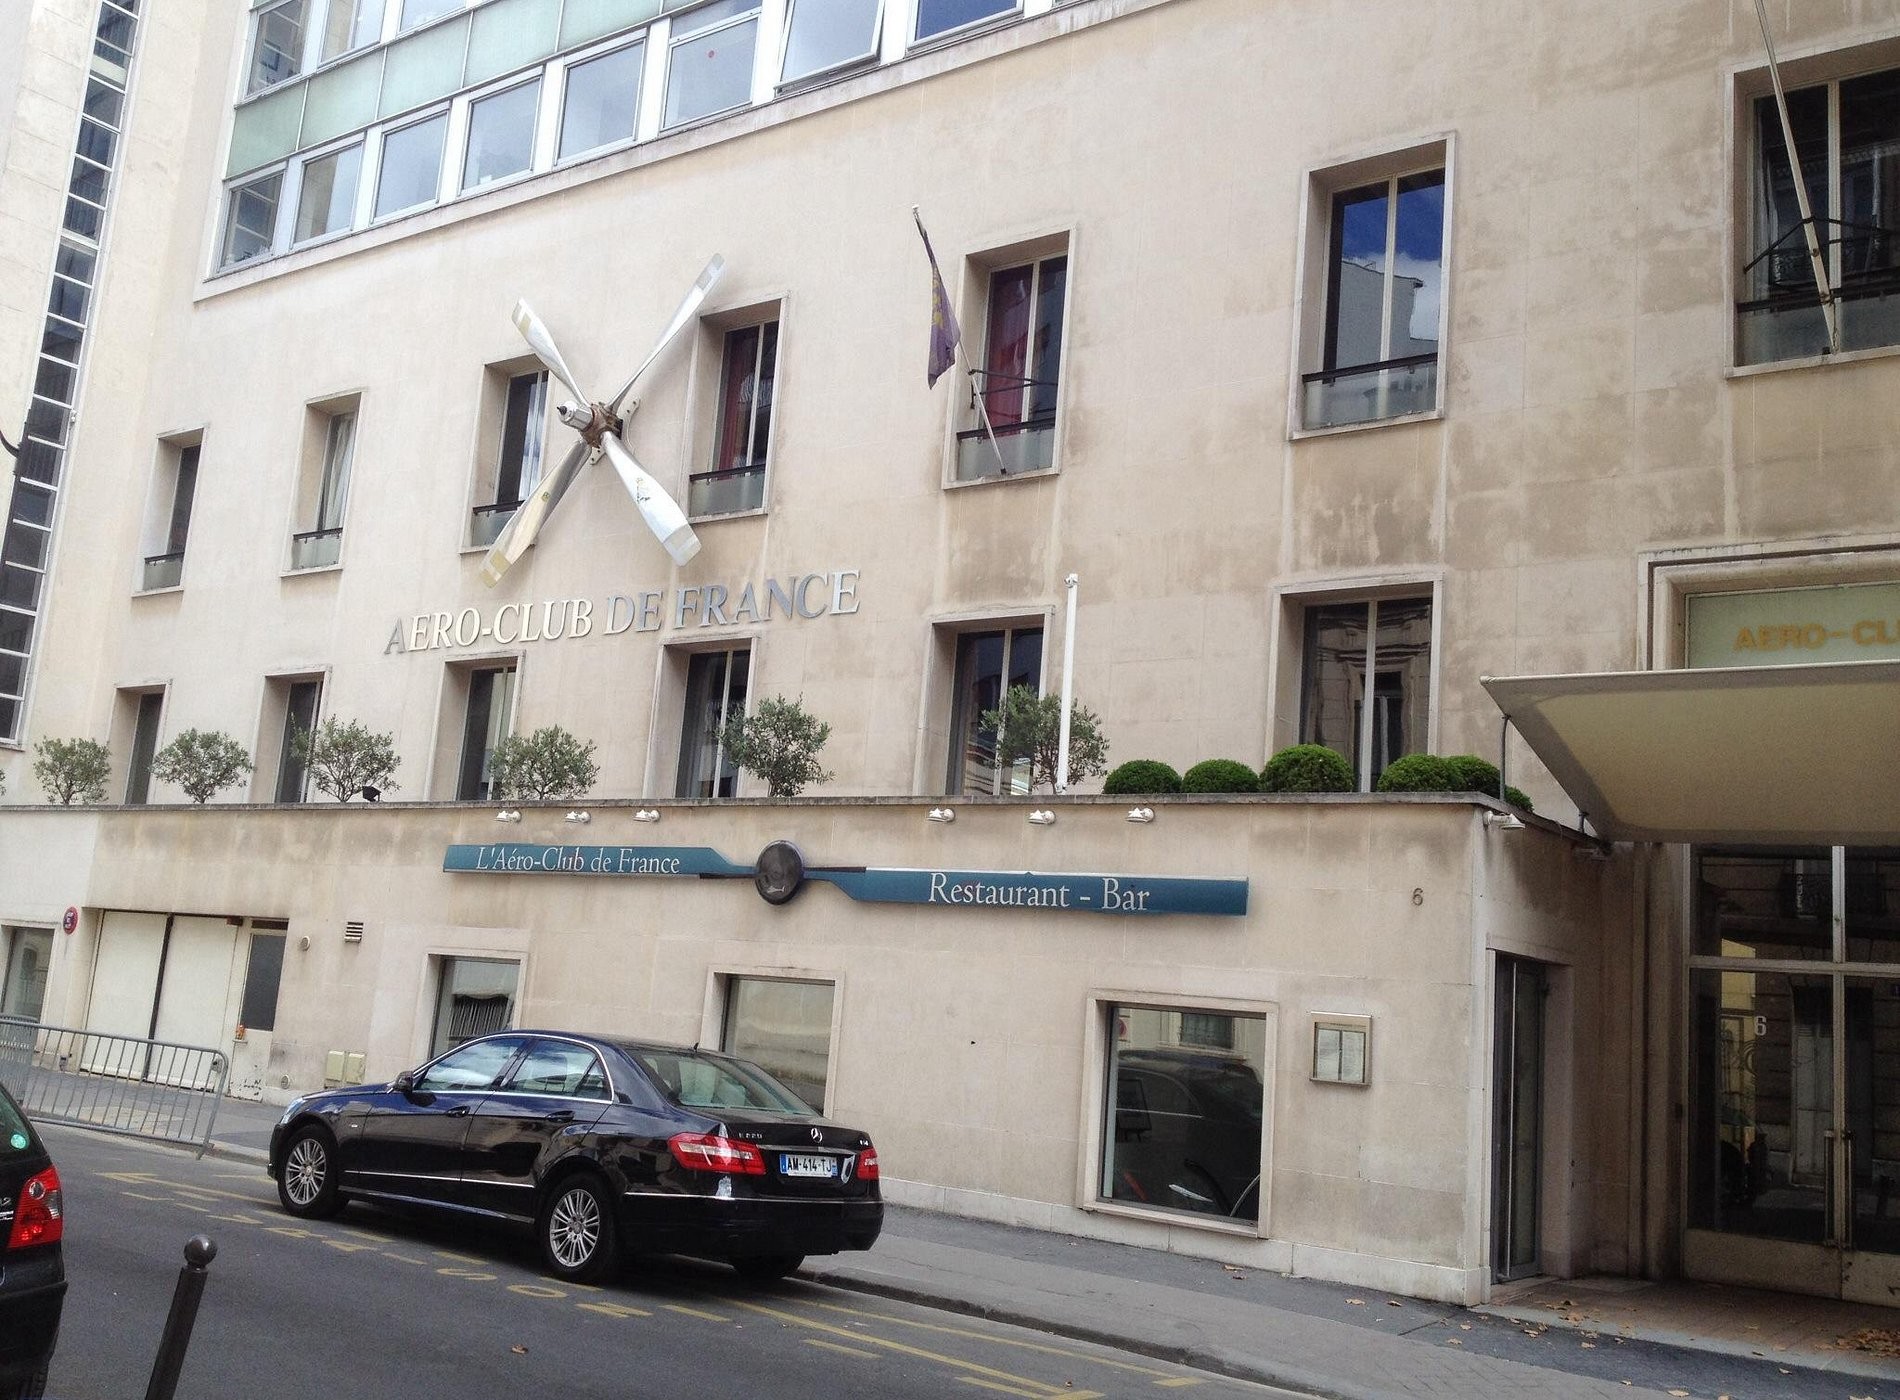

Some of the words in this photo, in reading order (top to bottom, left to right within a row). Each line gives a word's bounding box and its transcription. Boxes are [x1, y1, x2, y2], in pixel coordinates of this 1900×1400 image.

[383, 598, 594, 655] AERO-CLUB
[603, 591, 665, 635] DE
[673, 569, 862, 630] FRANCE
[1732, 618, 1900, 652] AERO-CL
[475, 847, 585, 871] L'Aéro-Club
[590, 847, 611, 872] de
[617, 848, 681, 874] France
[928, 872, 1071, 908] Restaurant
[1101, 877, 1150, 912] Bar
[1412, 887, 1424, 906] 6
[1753, 1015, 1767, 1036] 6
[788, 1157, 832, 1173] AM-414-TJ
